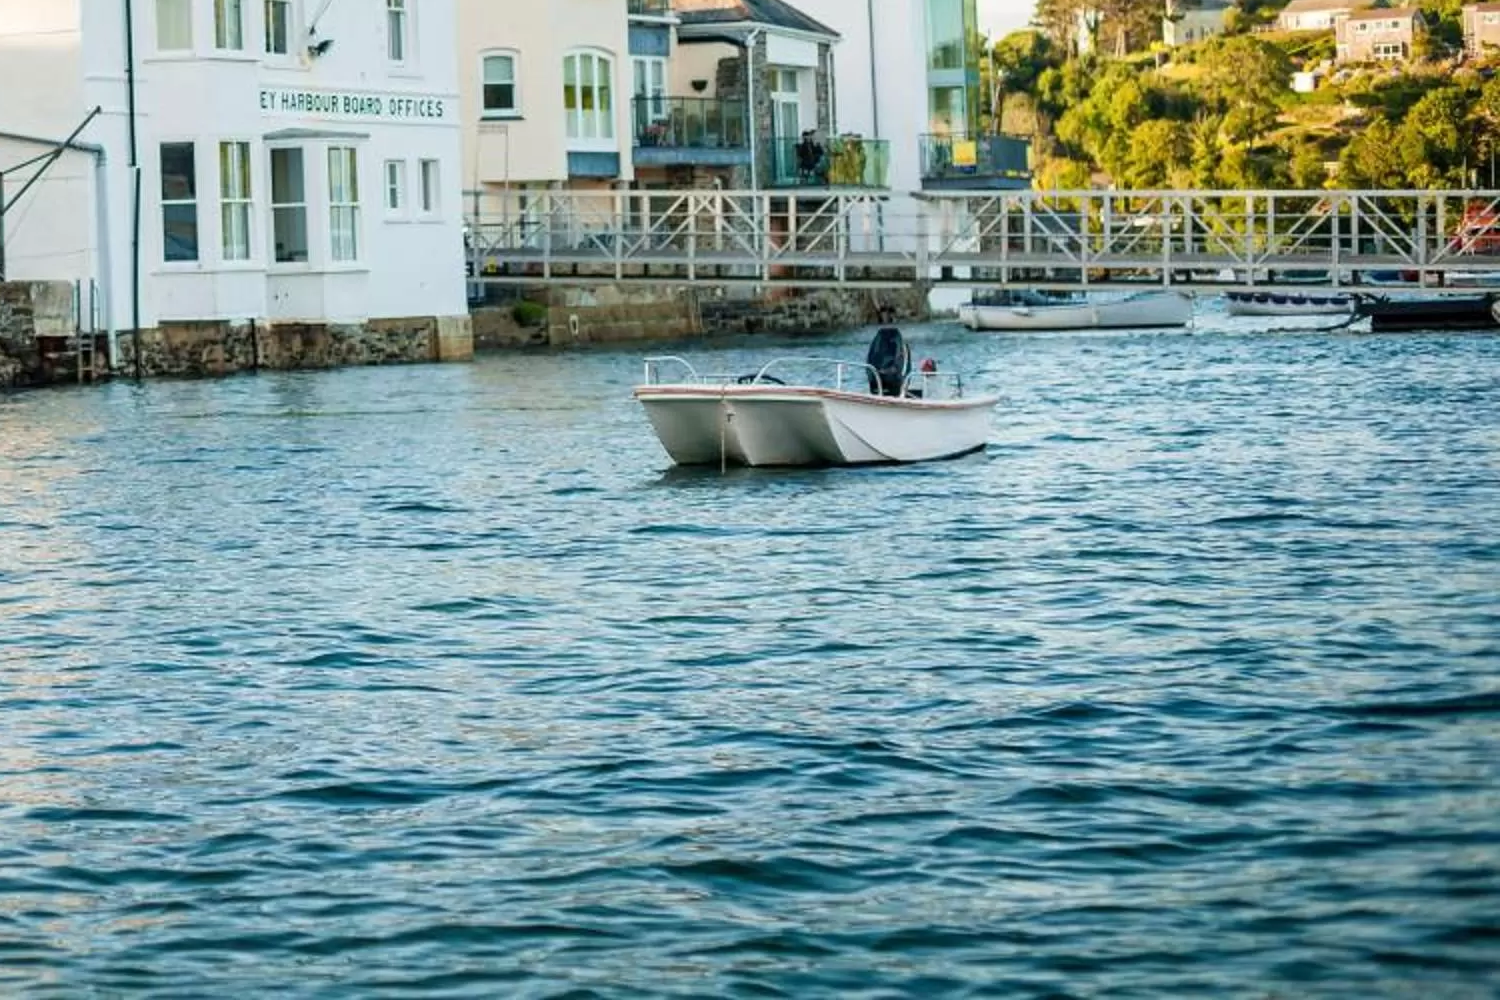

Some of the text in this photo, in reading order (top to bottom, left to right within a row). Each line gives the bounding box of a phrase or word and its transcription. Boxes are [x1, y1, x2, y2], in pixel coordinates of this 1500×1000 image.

[281, 92, 338, 113] HARBOUR
[343, 96, 382, 115] BOARD
[389, 99, 443, 117] OFFICES
